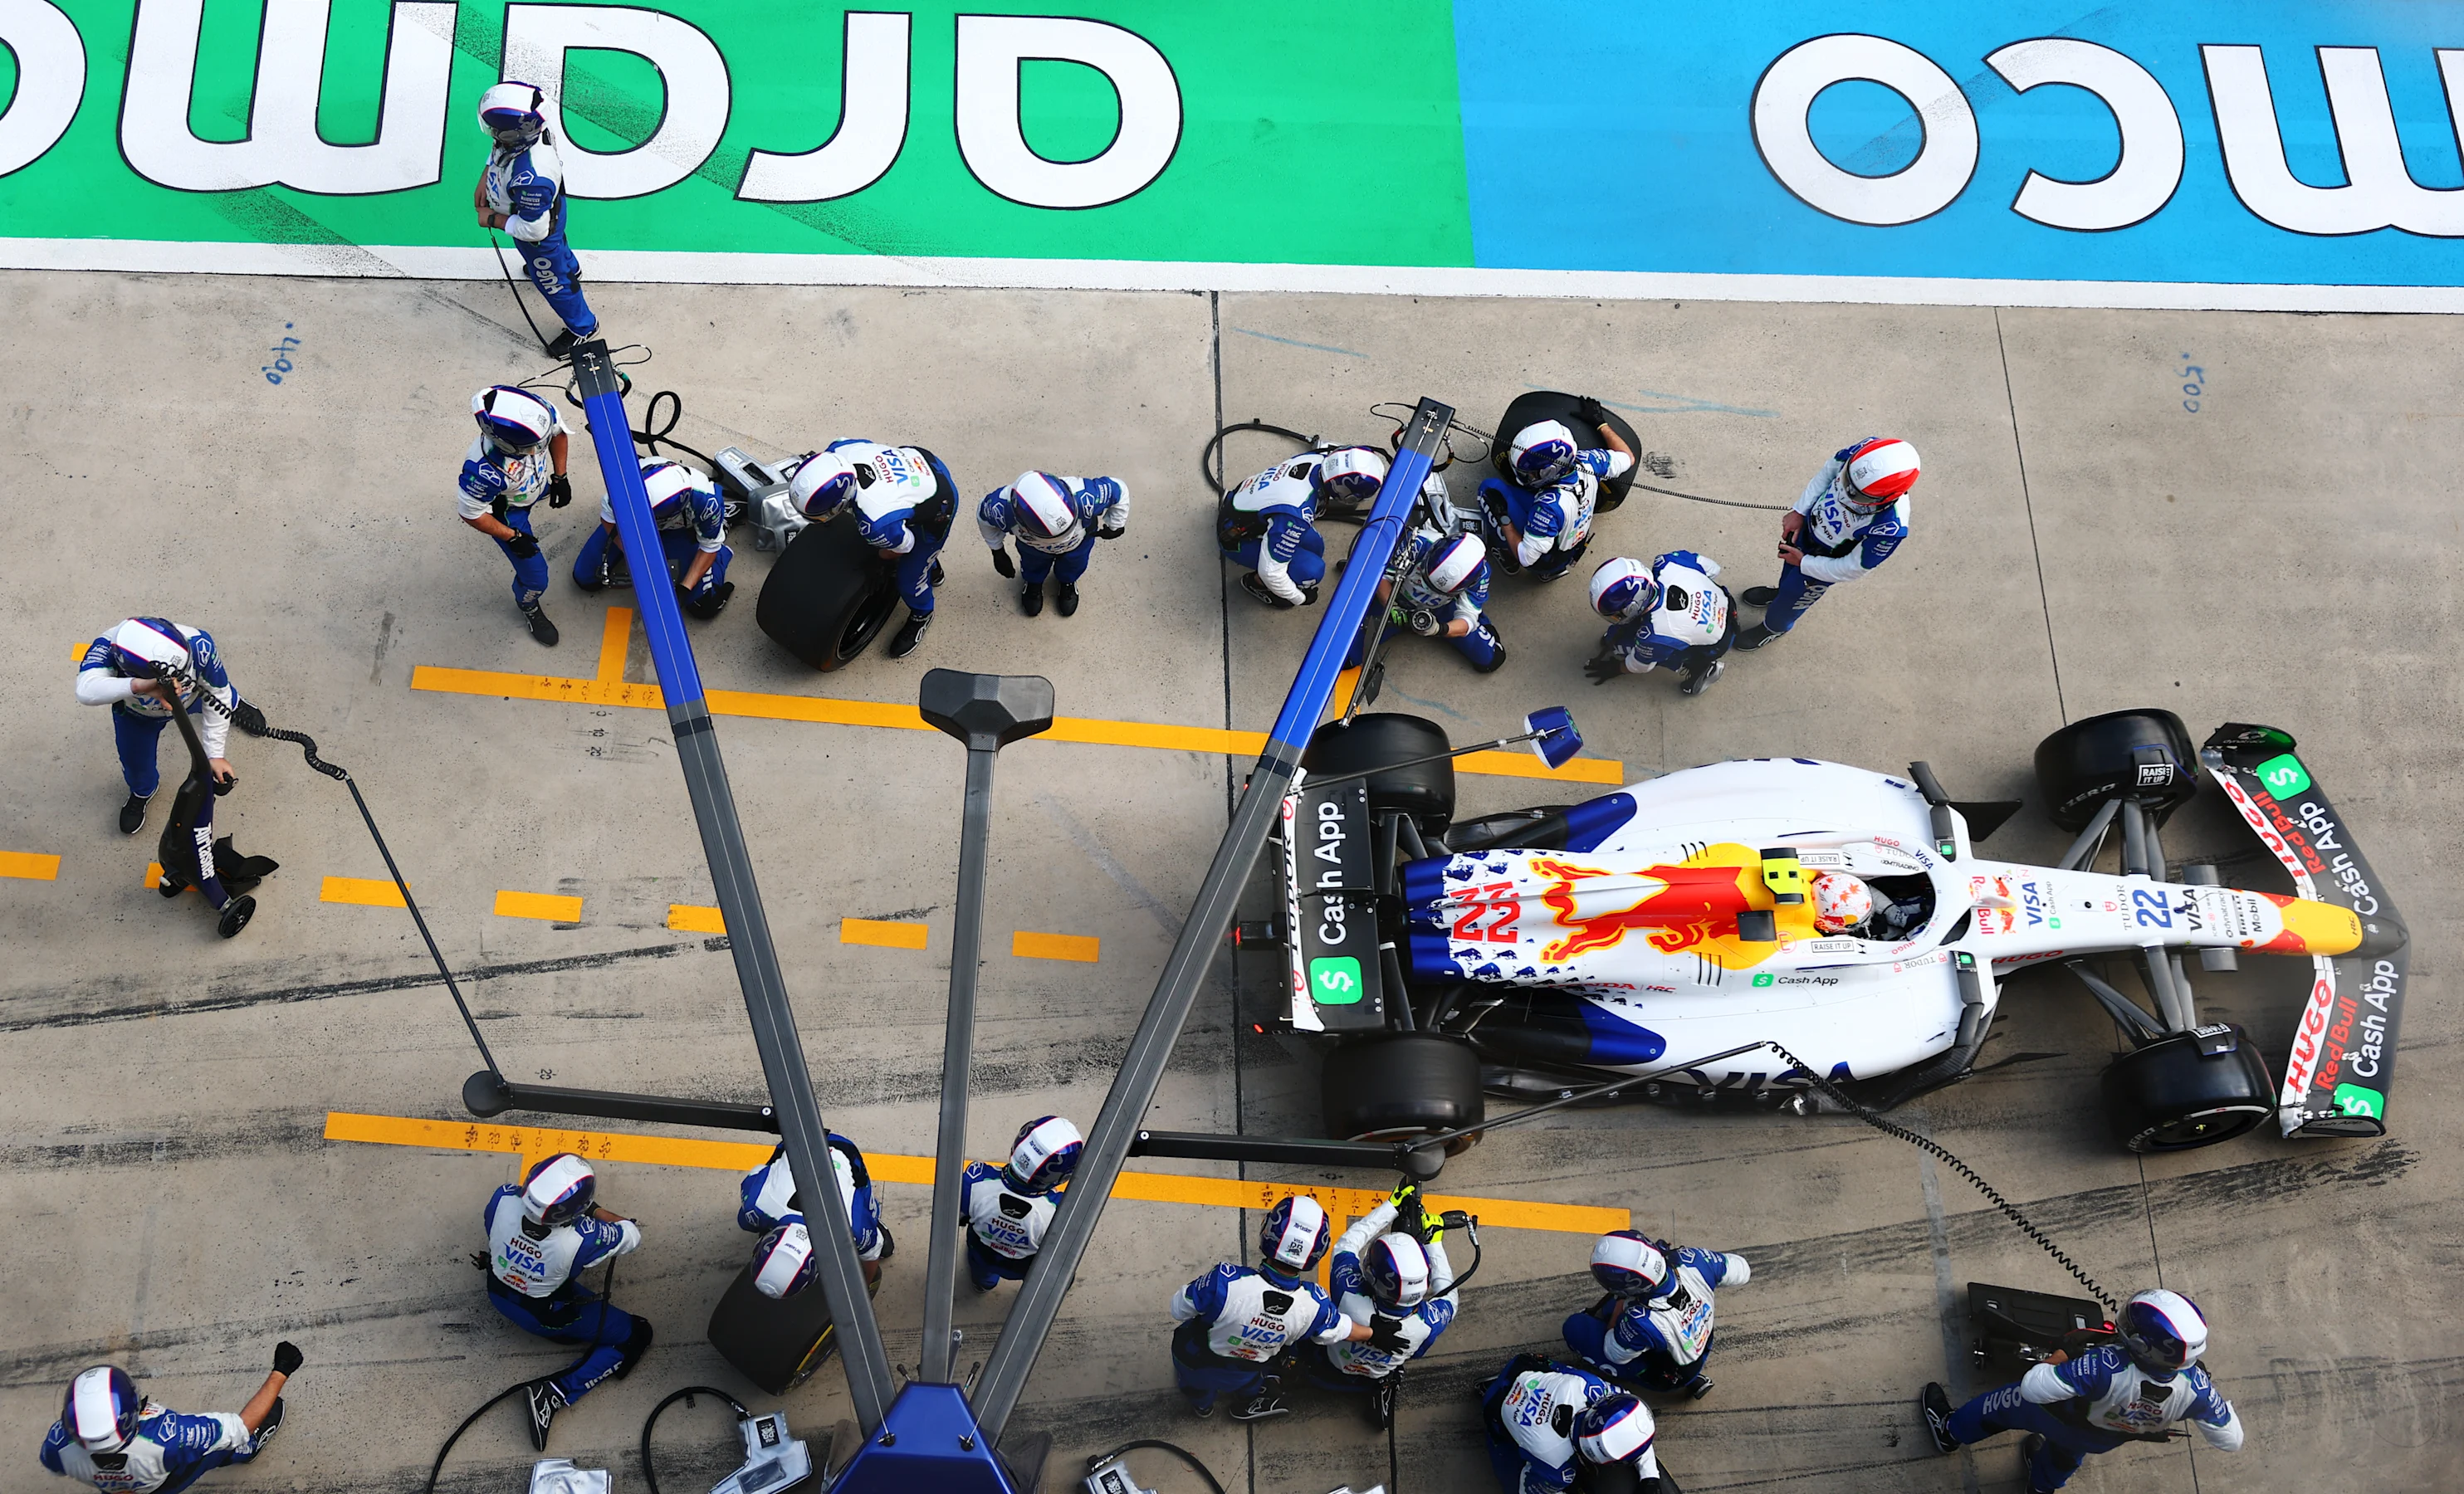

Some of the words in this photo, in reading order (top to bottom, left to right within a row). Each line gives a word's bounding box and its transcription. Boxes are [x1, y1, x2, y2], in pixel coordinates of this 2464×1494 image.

[532, 256, 565, 295] HUGO
[875, 456, 894, 483] HUGO
[881, 449, 908, 486] VISA
[1273, 463, 1288, 481] HUGO
[1841, 510, 1850, 528] HUGO
[1821, 525, 1833, 540] App
[1691, 591, 1702, 620] HUGO
[1695, 590, 1713, 627] VISA
[1792, 584, 1828, 610] HUGO
[2066, 783, 2116, 808] ZERO
[2251, 791, 2295, 832] Bull
[1314, 801, 1347, 864] App
[2299, 802, 2342, 852] App
[193, 821, 216, 881] Airtasker
[1874, 835, 1899, 847] HUGO
[2285, 832, 2327, 874] Red
[1915, 848, 1935, 871] VISA
[2046, 881, 2054, 896] App
[2331, 852, 2378, 916] Cash
[1316, 871, 1347, 945] Cash
[2022, 881, 2042, 927] VISA
[2048, 896, 2056, 915] Cash
[2117, 884, 2133, 930] TUDOR
[2132, 889, 2173, 929] 22
[2183, 889, 2202, 932] VISA
[2246, 899, 2261, 933] Mobil
[1452, 901, 1521, 944] 22
[1978, 908, 1994, 935] Bull
[1891, 940, 1916, 954] HUGO
[1992, 950, 2064, 964] HUGO
[1904, 957, 1936, 969] TUDOR
[1778, 976, 1810, 984] Cash
[1812, 976, 1839, 986] App
[2364, 959, 2399, 1013] App
[2287, 979, 2332, 1094] HUGO
[2315, 1040, 2344, 1091] Red
[2330, 995, 2359, 1044] Bull
[2352, 1014, 2388, 1078] Cash
[984, 1222, 1029, 1246] VISA
[991, 1218, 1025, 1234] HUGO
[510, 1238, 543, 1259] HUGO
[518, 1234, 540, 1249] HONDA
[990, 1242, 1004, 1251] Red
[1004, 1247, 1016, 1257] Bull
[503, 1242, 545, 1277] VISA
[502, 1276, 516, 1287] Red
[510, 1266, 527, 1277] Cash
[529, 1274, 543, 1283] App
[1250, 1317, 1285, 1331] HUGO
[1259, 1312, 1283, 1322] HONDA
[1680, 1298, 1703, 1327] HUGO
[1681, 1302, 1712, 1338] VISA
[1241, 1324, 1287, 1344] VISA
[1244, 1341, 1263, 1350] Cash
[1349, 1341, 1393, 1365] VISA
[1518, 1390, 1528, 1407] Cash
[1520, 1388, 1546, 1427] VISA
[1536, 1393, 1552, 1425] HUGO
[1982, 1385, 2022, 1415] HUGO
[2127, 1400, 2163, 1415] HUGO
[2118, 1404, 2163, 1423] VISA
[92, 1474, 134, 1482] HUGO
